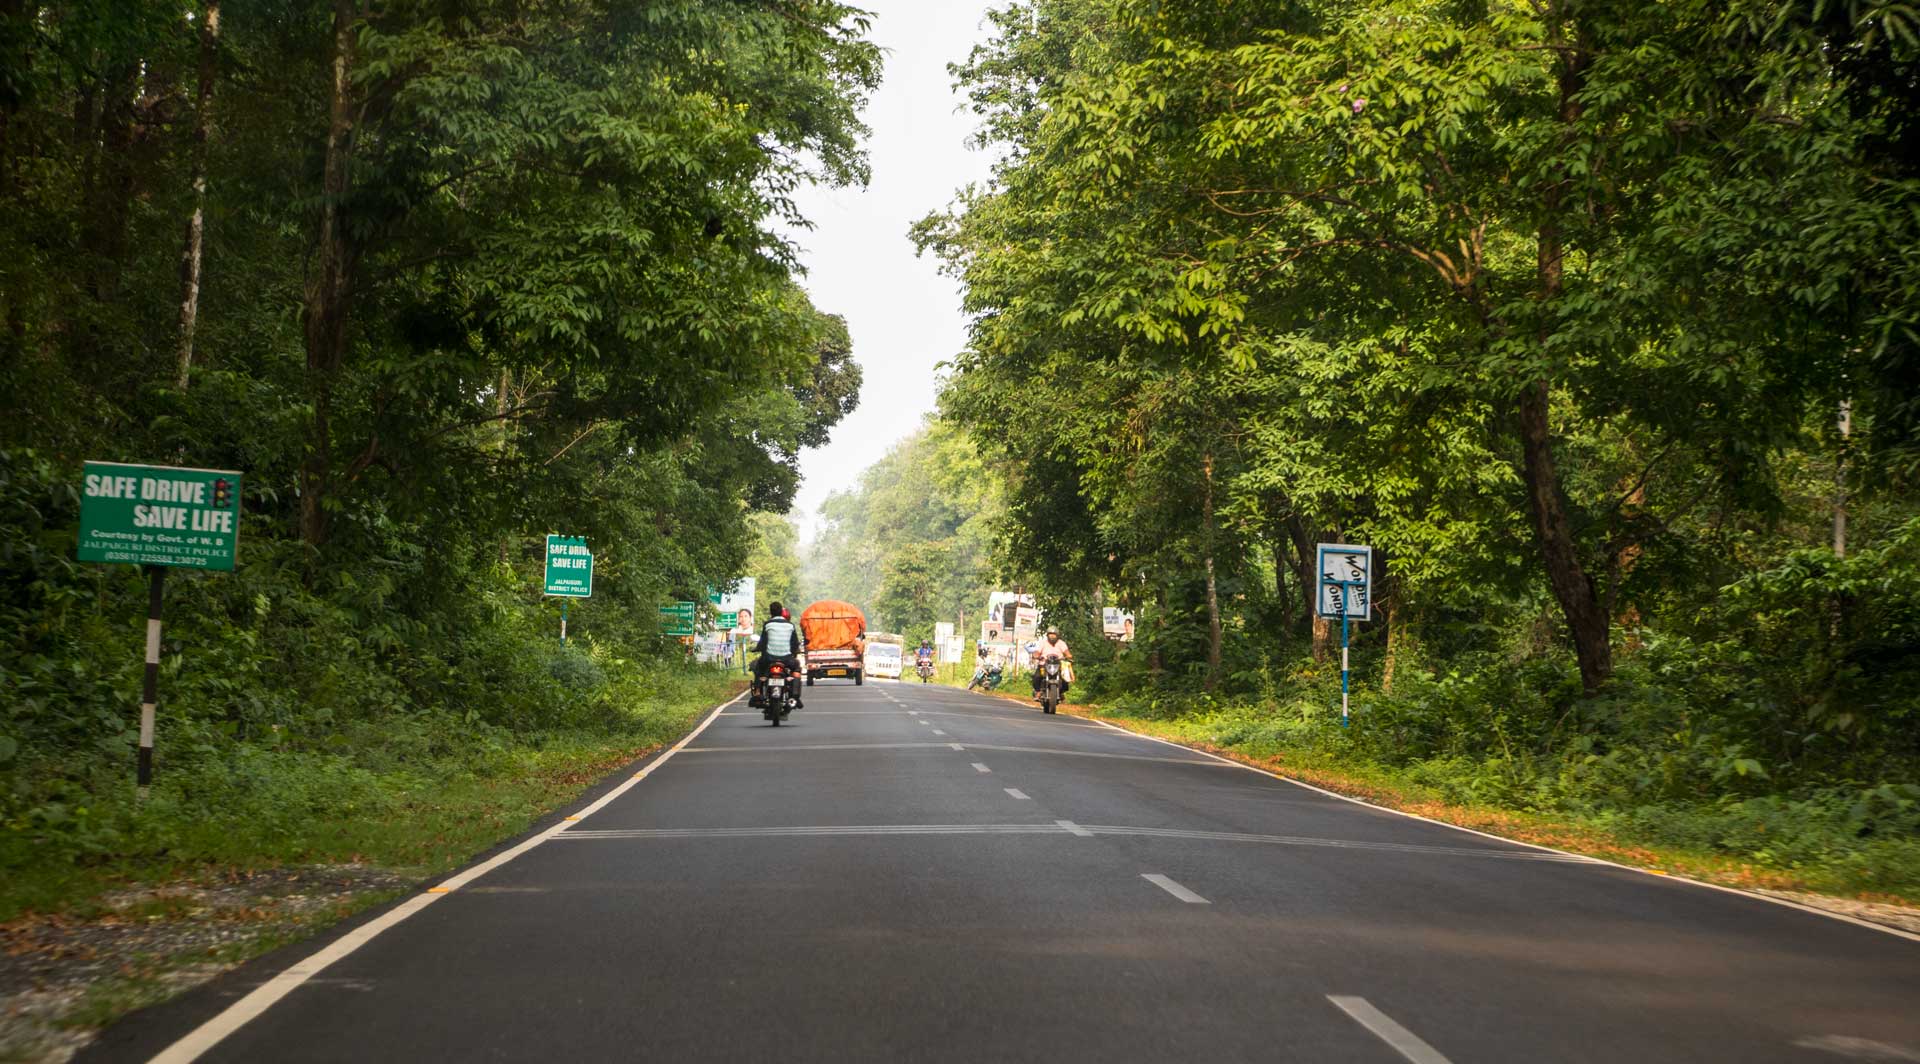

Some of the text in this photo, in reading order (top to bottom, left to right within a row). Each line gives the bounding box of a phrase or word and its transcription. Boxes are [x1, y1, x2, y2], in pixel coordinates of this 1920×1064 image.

[85, 474, 206, 504] SAFE DRIVE
[133, 504, 233, 533] SAVE LIFE
[91, 529, 139, 541] Courtesy
[141, 533, 154, 543] by
[157, 534, 184, 544] Govt.
[187, 536, 198, 544] of
[215, 537, 224, 546] B
[145, 544, 191, 555] DISTRICT
[193, 548, 229, 557] POLICE
[550, 544, 568, 555] SAFE
[552, 557, 587, 569] SAVE LIFE
